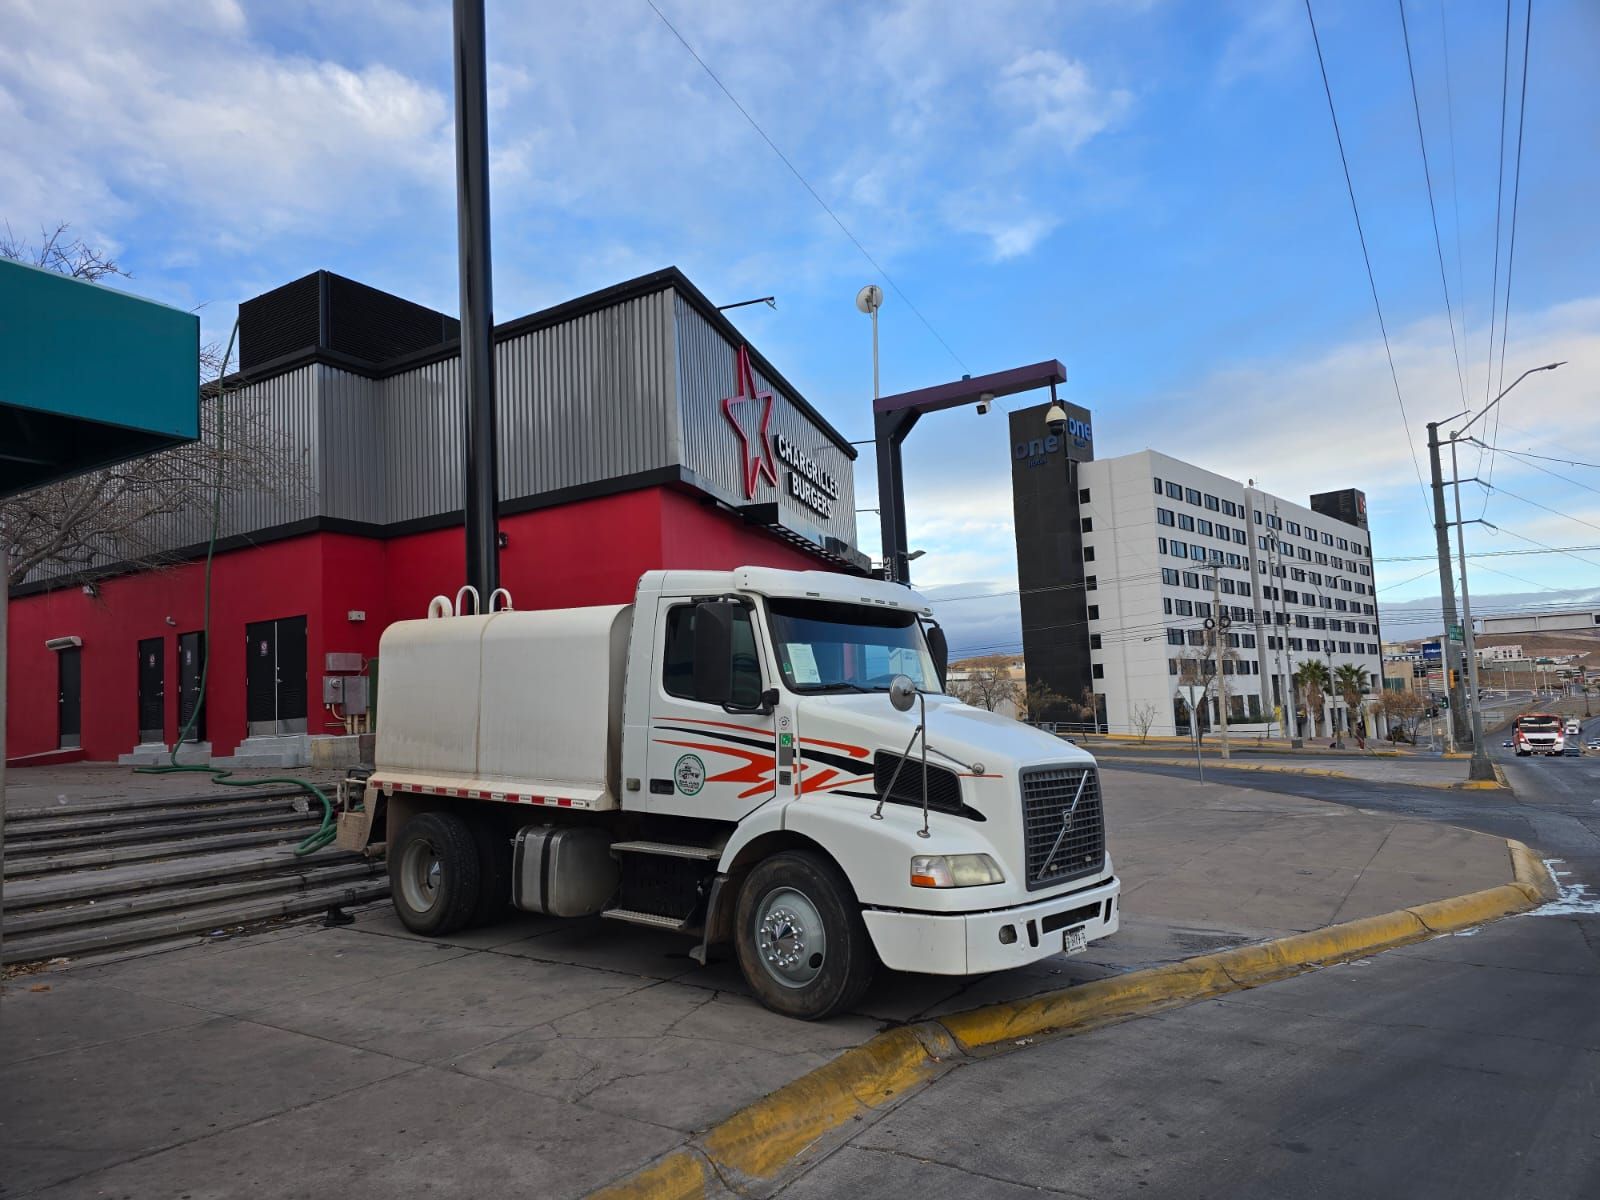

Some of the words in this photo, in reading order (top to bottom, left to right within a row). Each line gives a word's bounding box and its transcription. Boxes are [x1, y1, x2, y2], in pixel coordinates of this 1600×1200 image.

[778, 434, 840, 499] CHARGRILLED
[1014, 434, 1058, 459] one
[792, 472, 832, 518] BURGERS
